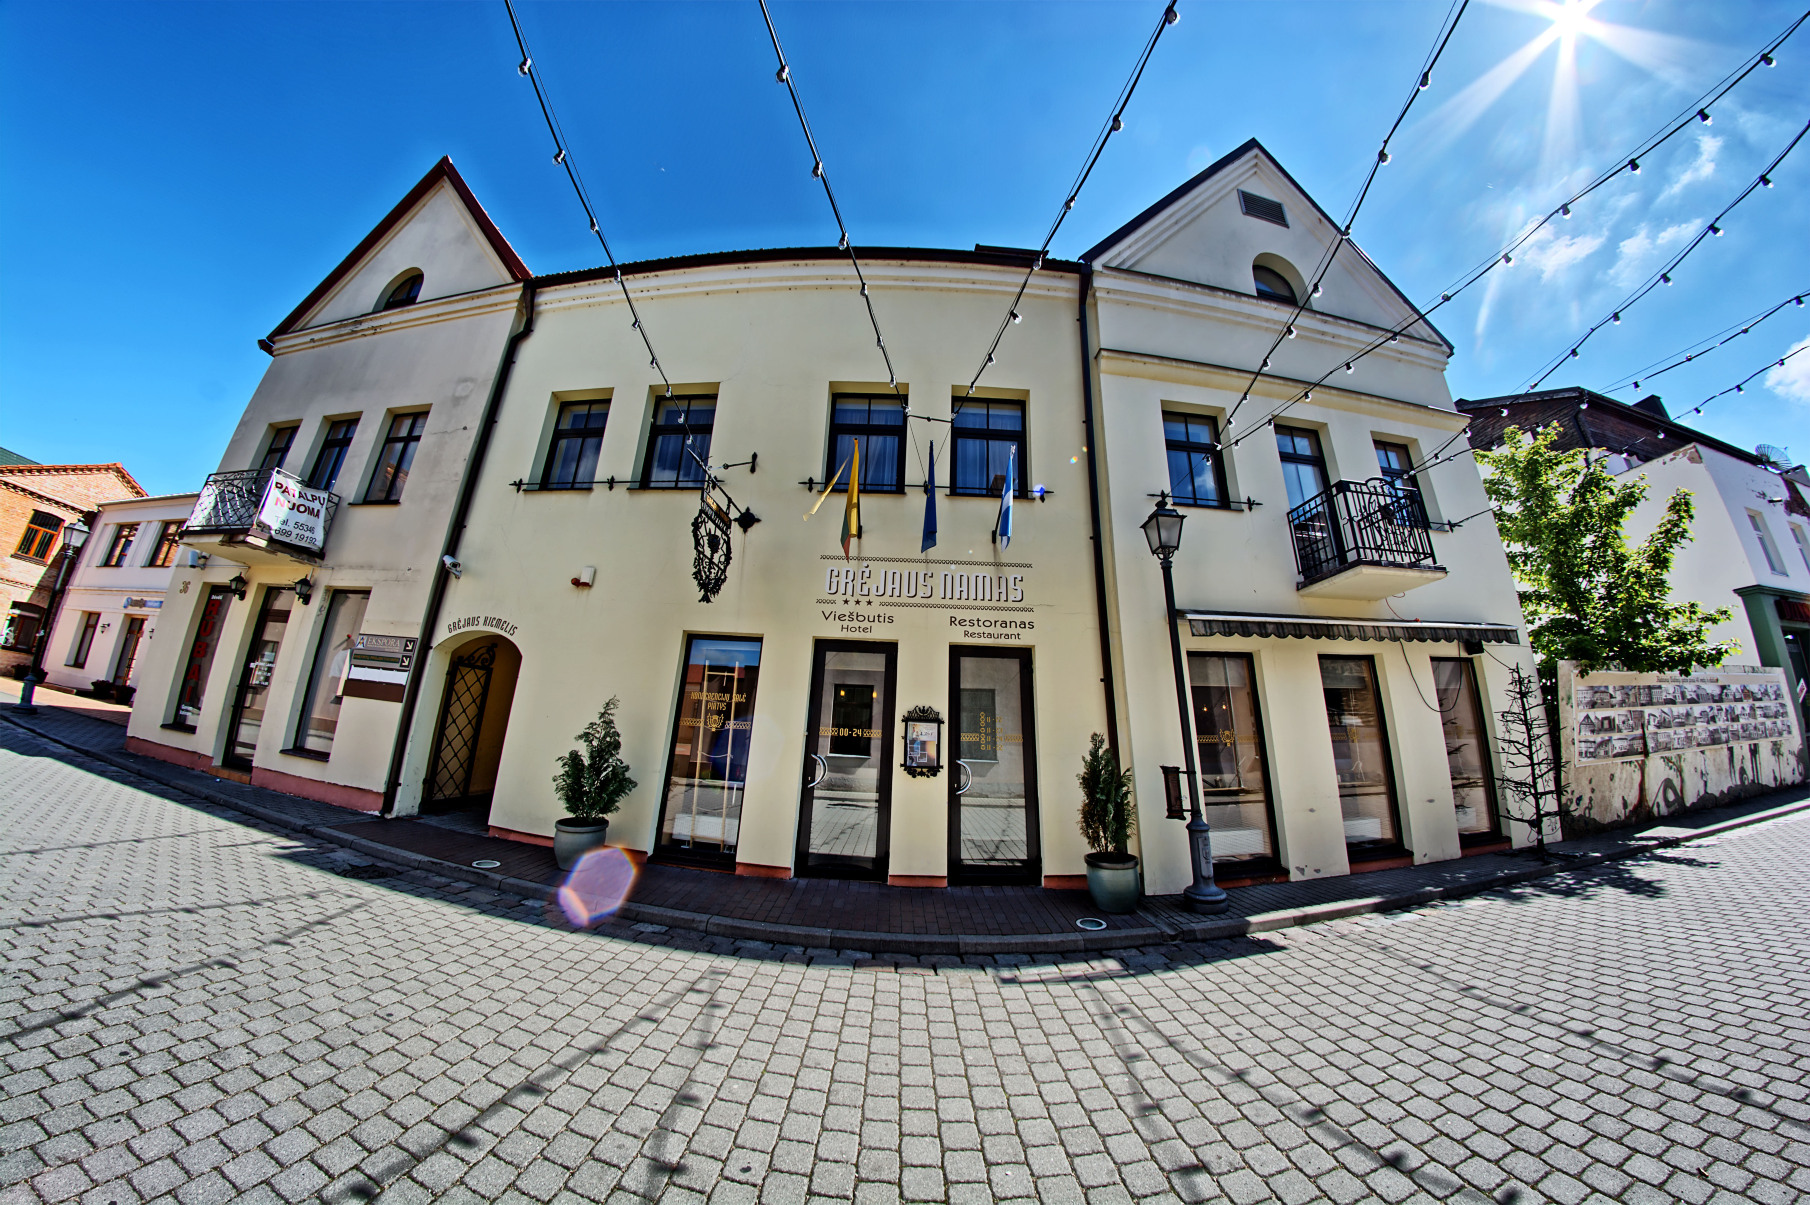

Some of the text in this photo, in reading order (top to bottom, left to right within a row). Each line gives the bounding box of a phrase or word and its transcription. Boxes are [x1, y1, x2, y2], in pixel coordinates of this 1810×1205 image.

[275, 482, 326, 508] PATALPŲ
[275, 497, 320, 519] NUOMA
[824, 563, 1024, 602] GRĖJAUS NAMAS
[447, 616, 518, 636] GRĖJAUS KIEMELIS
[821, 610, 1035, 630] Viešbutis Restoranas
[367, 636, 400, 647] EKSPORA
[840, 624, 1021, 640] Hotel Restaurant
